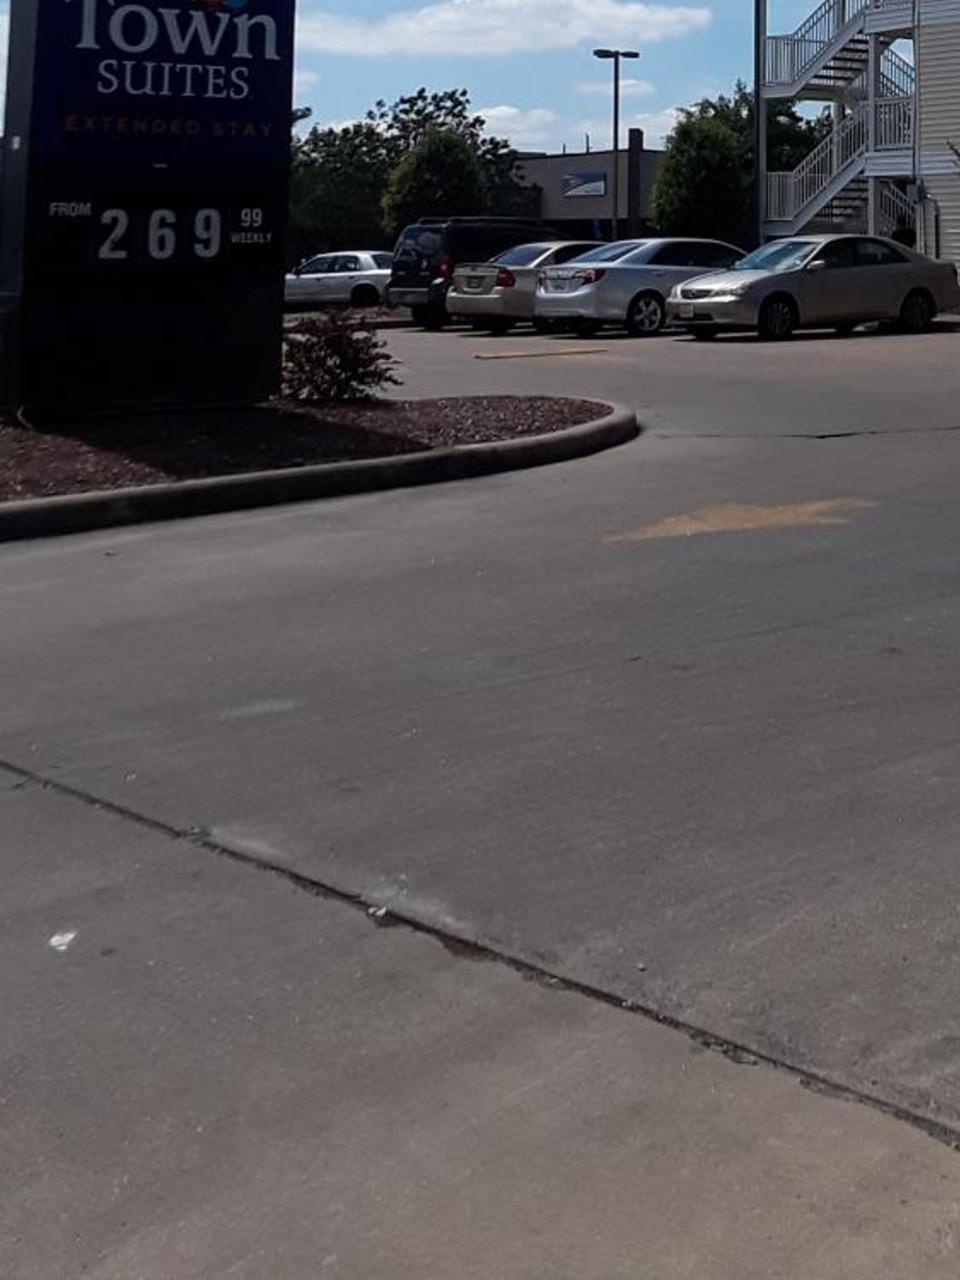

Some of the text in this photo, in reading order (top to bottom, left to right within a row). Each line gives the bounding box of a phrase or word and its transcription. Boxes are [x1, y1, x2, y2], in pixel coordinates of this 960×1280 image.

[97, 58, 250, 100] SUITES
[65, 114, 273, 137] EXTENDED STAY
[49, 203, 92, 217] FROM
[240, 207, 263, 228] 99
[231, 231, 272, 245] WEEKLY
